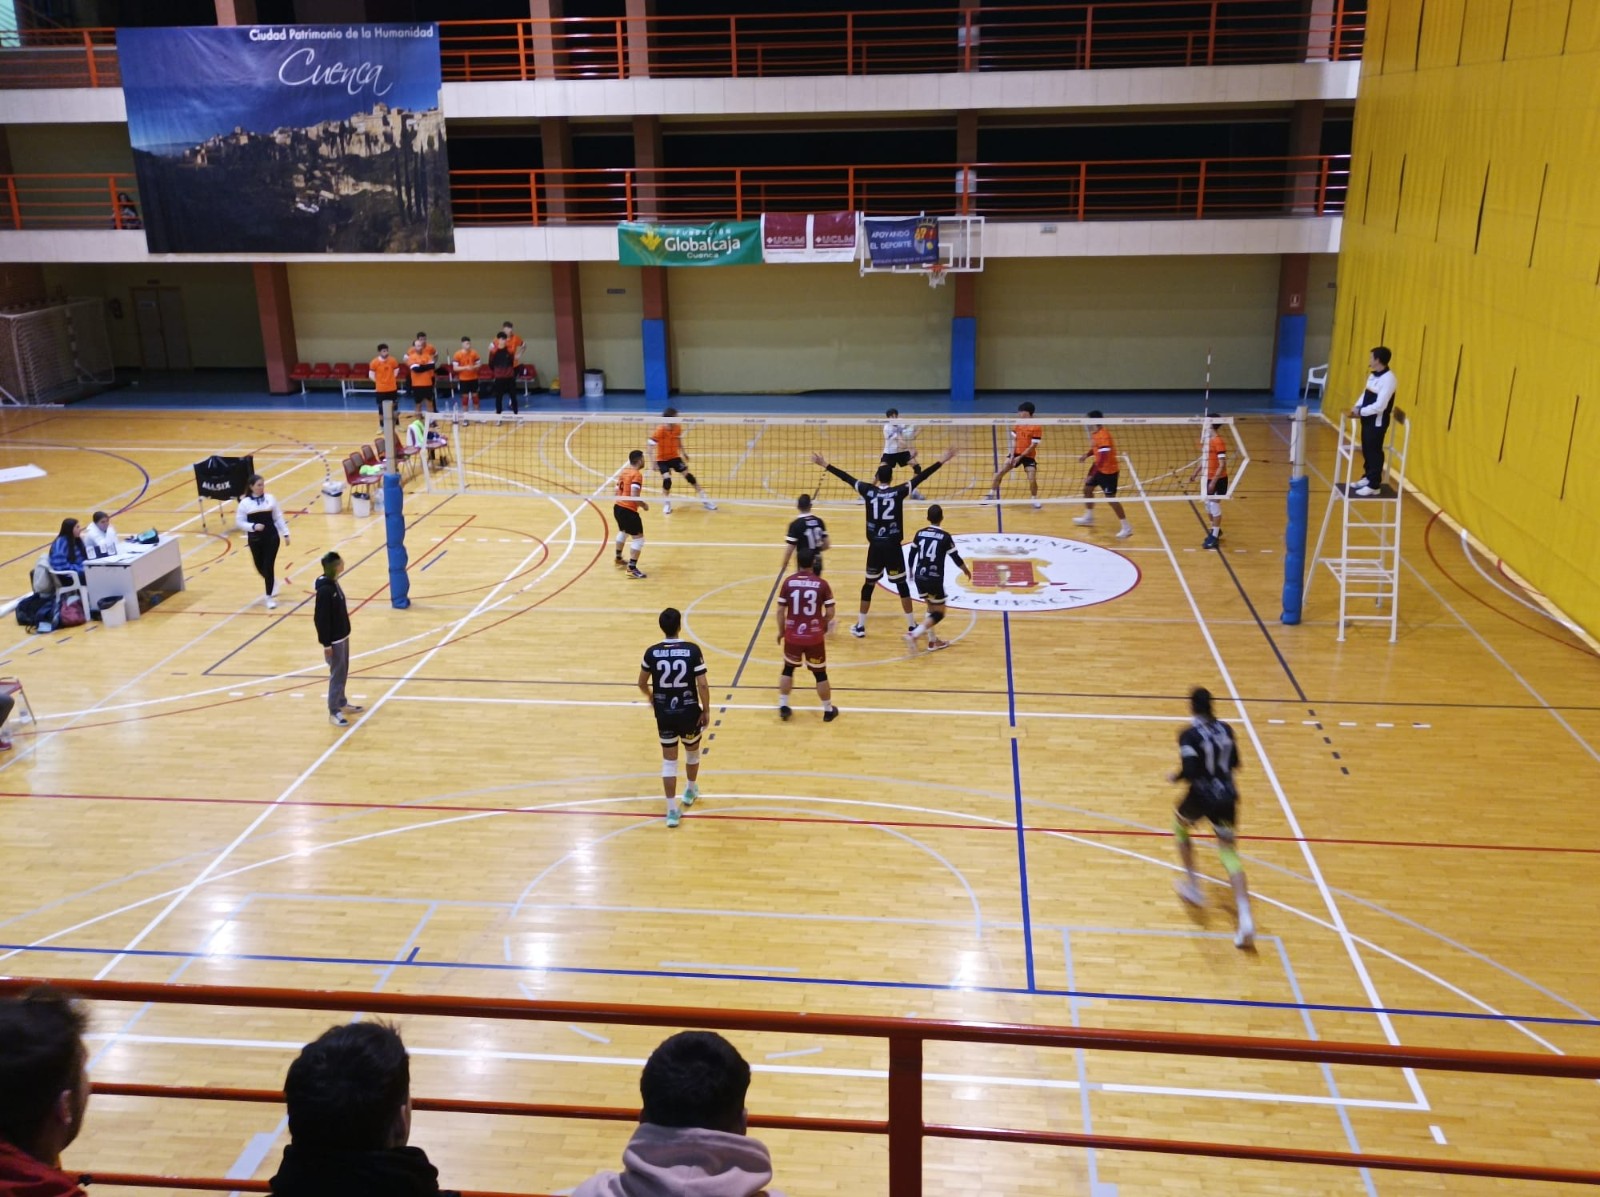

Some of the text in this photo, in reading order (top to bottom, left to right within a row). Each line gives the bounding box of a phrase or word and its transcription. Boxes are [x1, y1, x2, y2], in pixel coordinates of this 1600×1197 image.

[250, 26, 434, 41] Ciudad Patrimonio de la Humanidad
[278, 47, 393, 97] Cuenca
[772, 236, 806, 245] UCLM
[821, 235, 855, 244] UCLM
[871, 230, 911, 239] APOYANDO
[664, 236, 741, 255] Globalcaja
[869, 241, 913, 250] EL DEPORTE
[686, 252, 719, 260] Cuenca
[202, 481, 231, 491] ALLSIX
[870, 498, 896, 520] 12
[918, 538, 938, 562] 14
[956, 537, 1088, 553] NTAMIENTO
[790, 589, 818, 616] 13
[656, 659, 689, 688] 22
